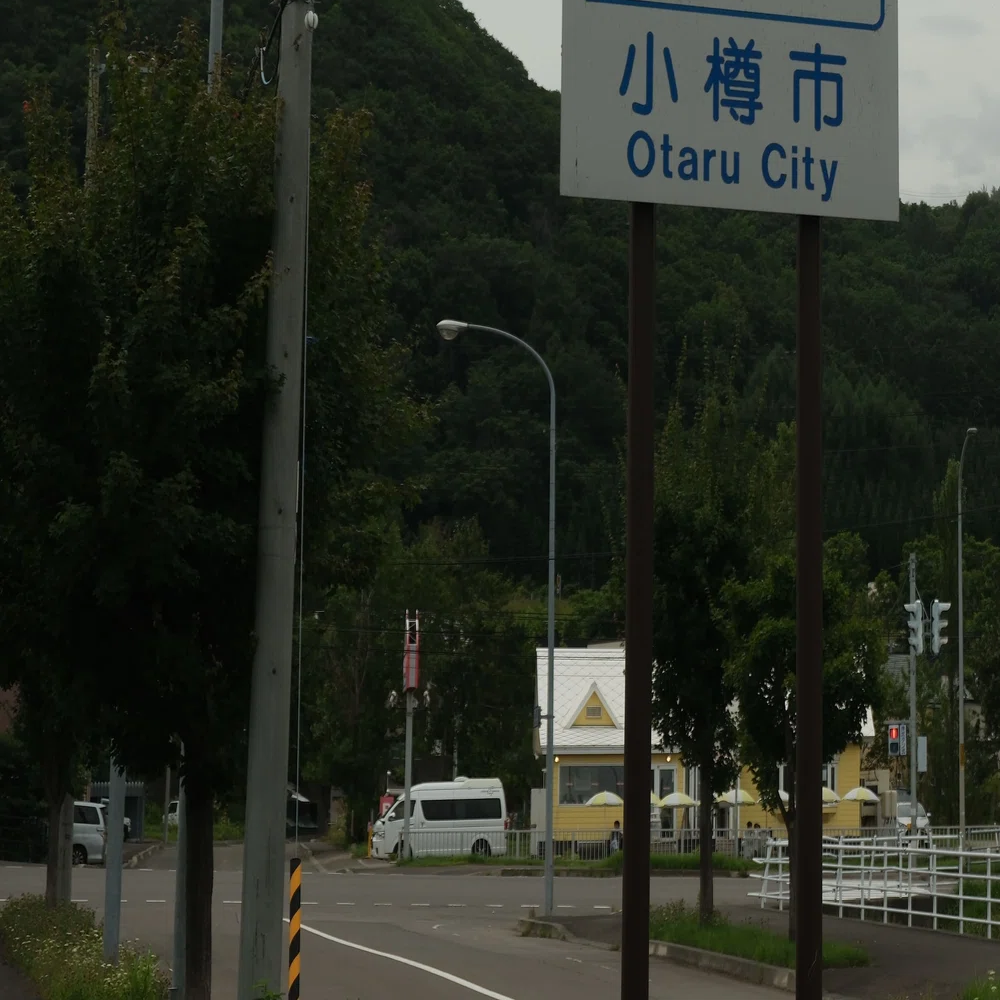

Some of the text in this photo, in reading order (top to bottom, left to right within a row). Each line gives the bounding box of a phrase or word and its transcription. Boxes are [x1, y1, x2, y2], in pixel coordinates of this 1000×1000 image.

[619, 31, 847, 131] 小樽市
[627, 129, 838, 201] Otaru City
